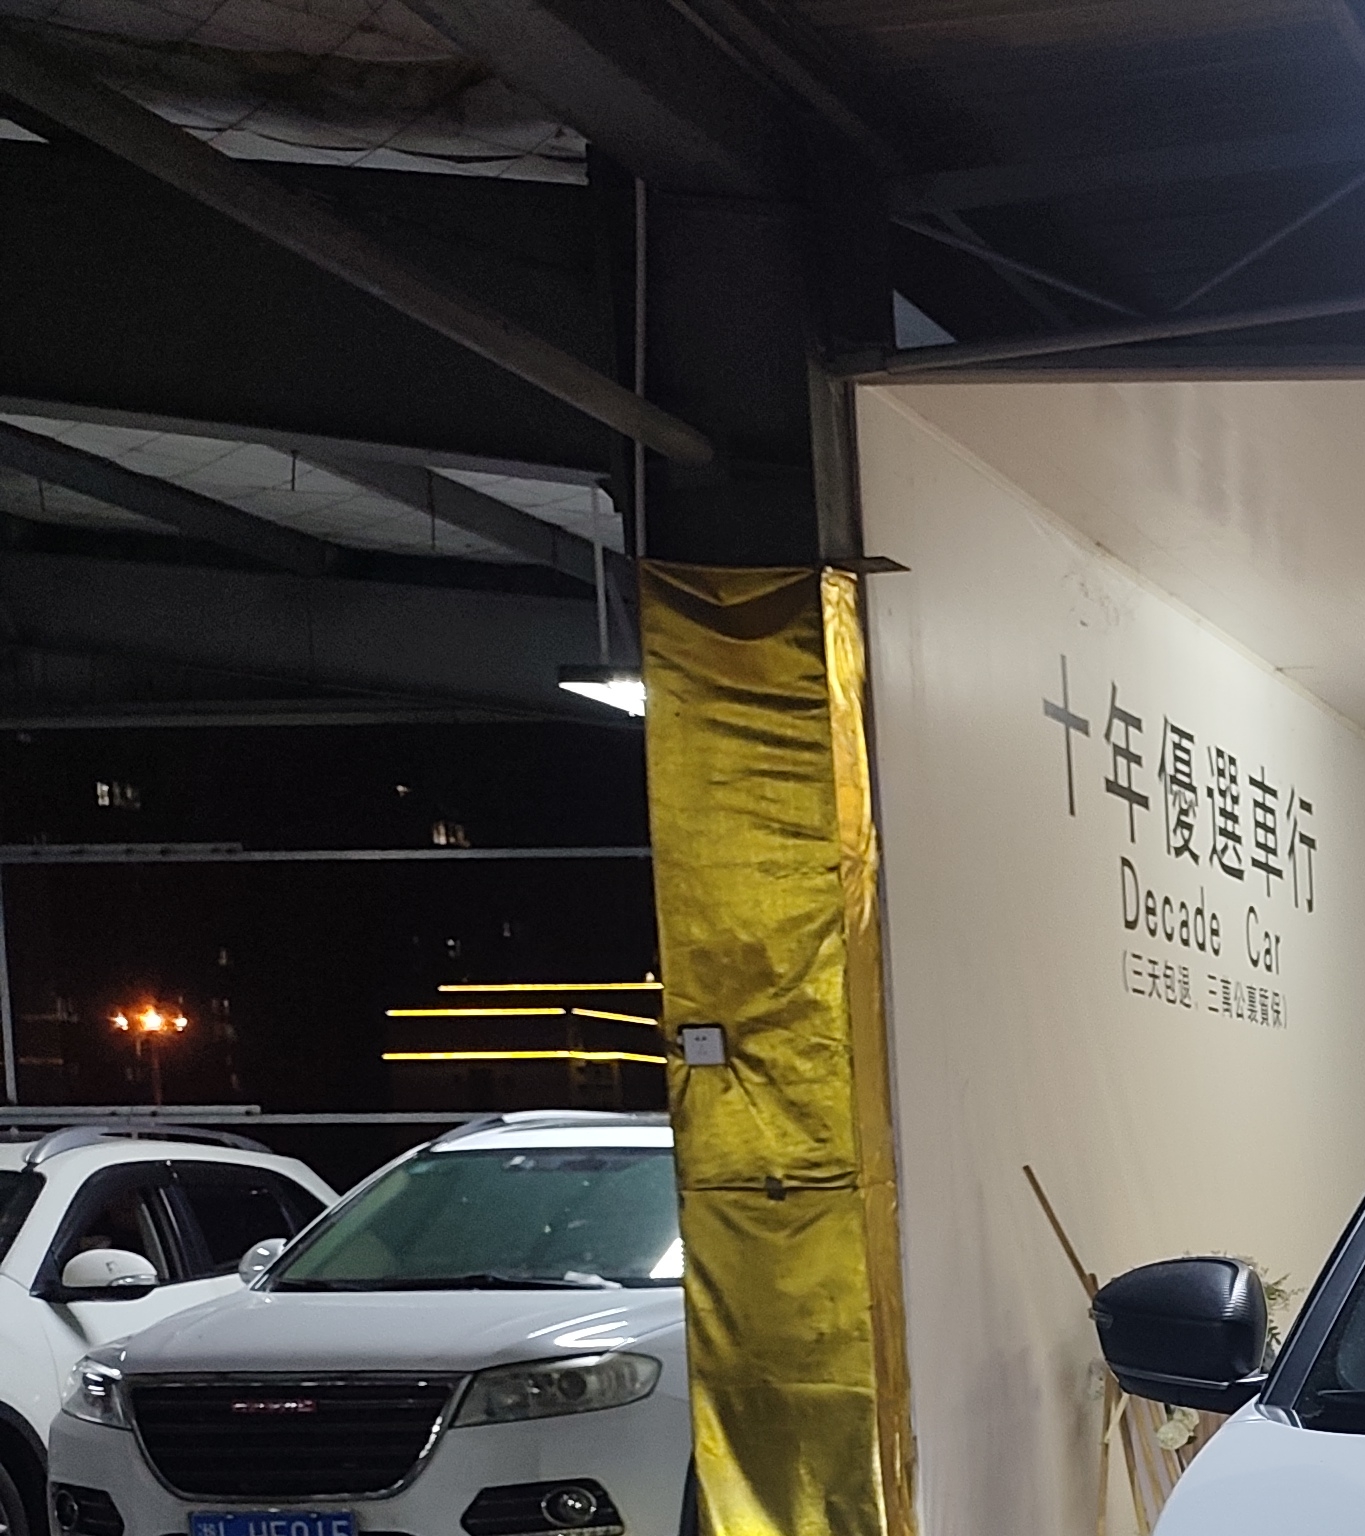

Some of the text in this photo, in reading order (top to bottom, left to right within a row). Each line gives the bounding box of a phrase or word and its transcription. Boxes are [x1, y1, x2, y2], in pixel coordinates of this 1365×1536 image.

[1043, 654, 1317, 913] 十年優選車行
[1120, 856, 1281, 975] Decade Car
